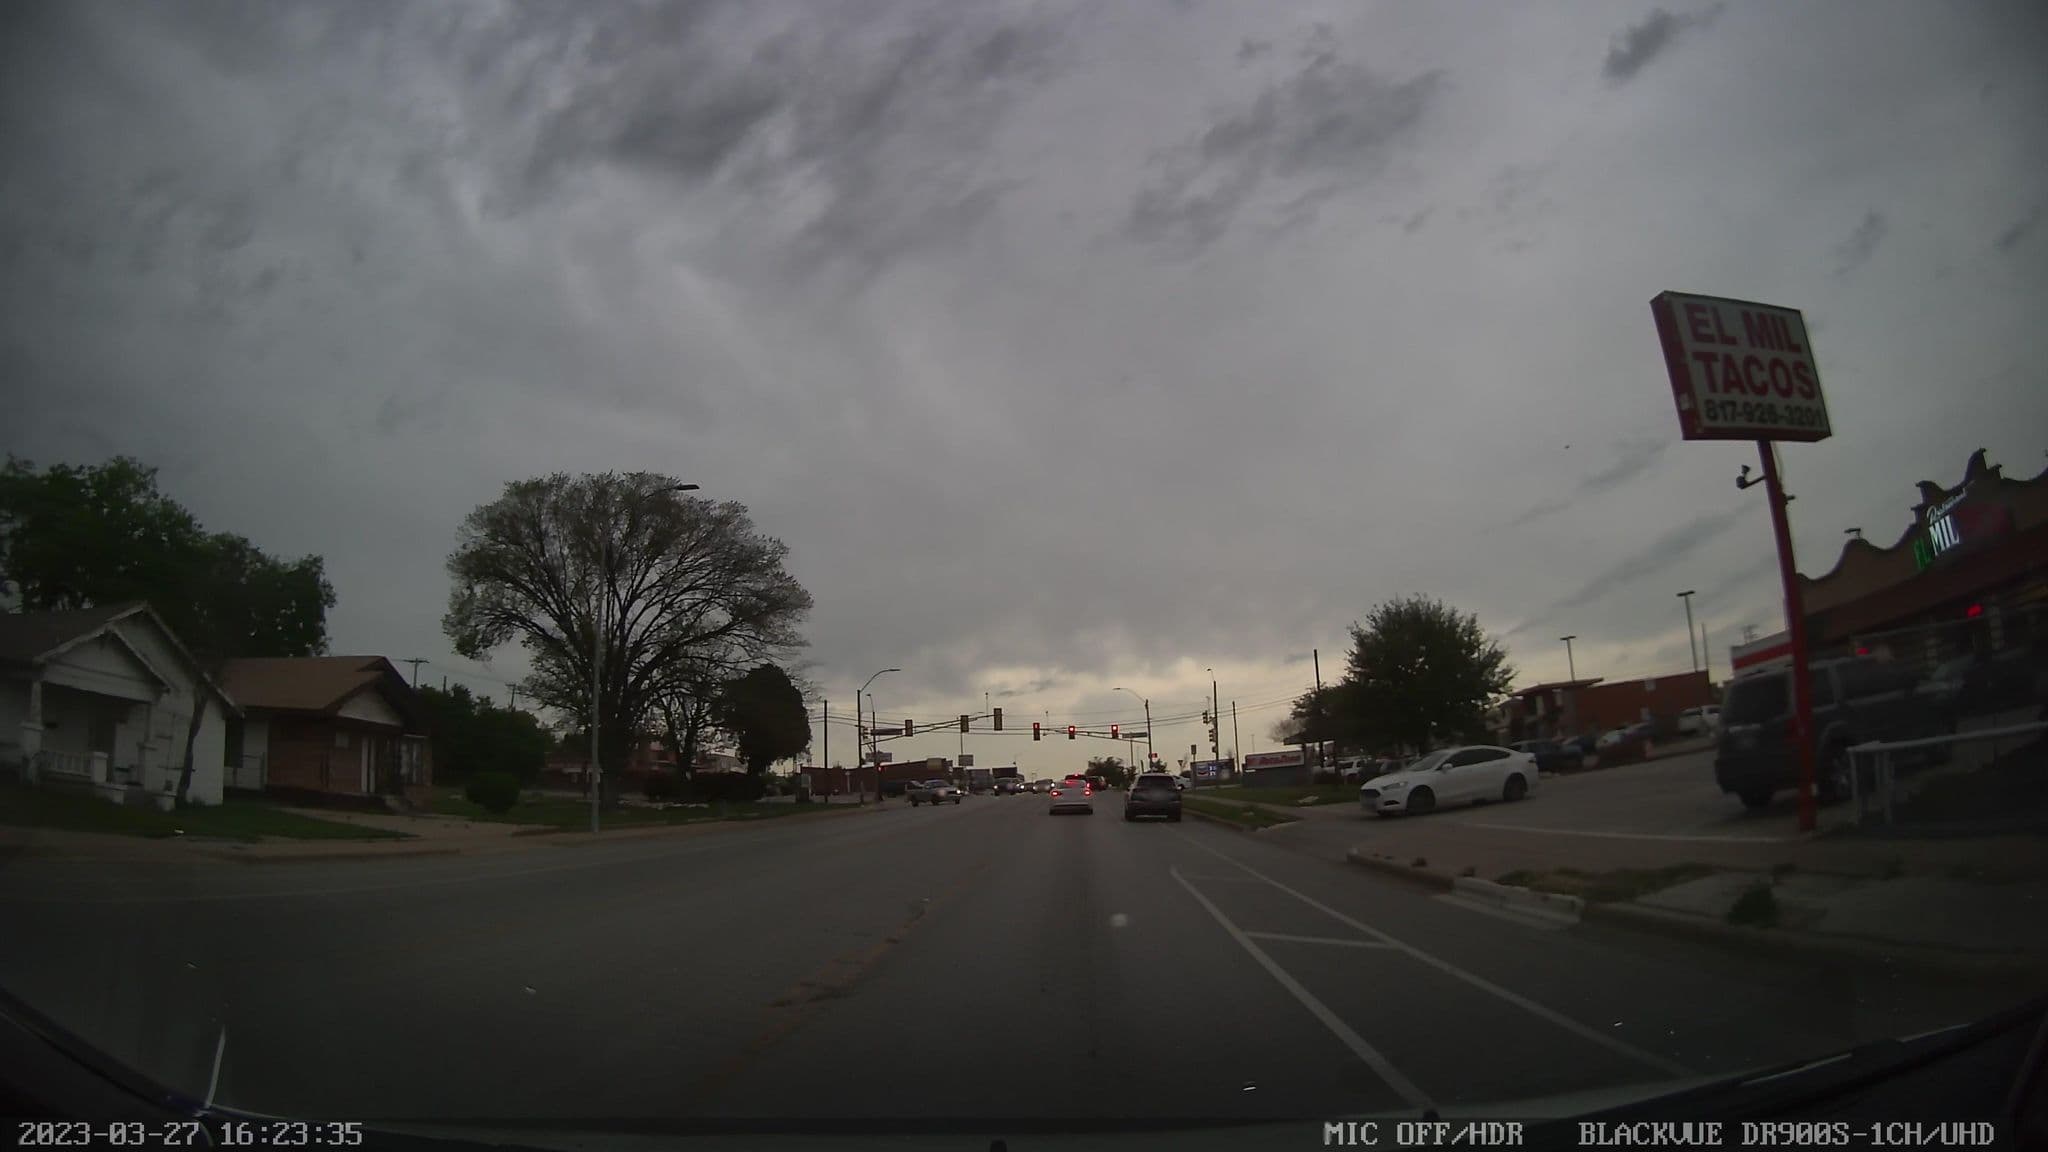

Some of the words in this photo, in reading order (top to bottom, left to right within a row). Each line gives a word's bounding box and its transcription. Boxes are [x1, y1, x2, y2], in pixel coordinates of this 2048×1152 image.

[1686, 304, 1738, 345] EL
[1743, 311, 1801, 352] MIL
[1693, 352, 1816, 399] TACOS
[1928, 514, 1961, 558] MIL
